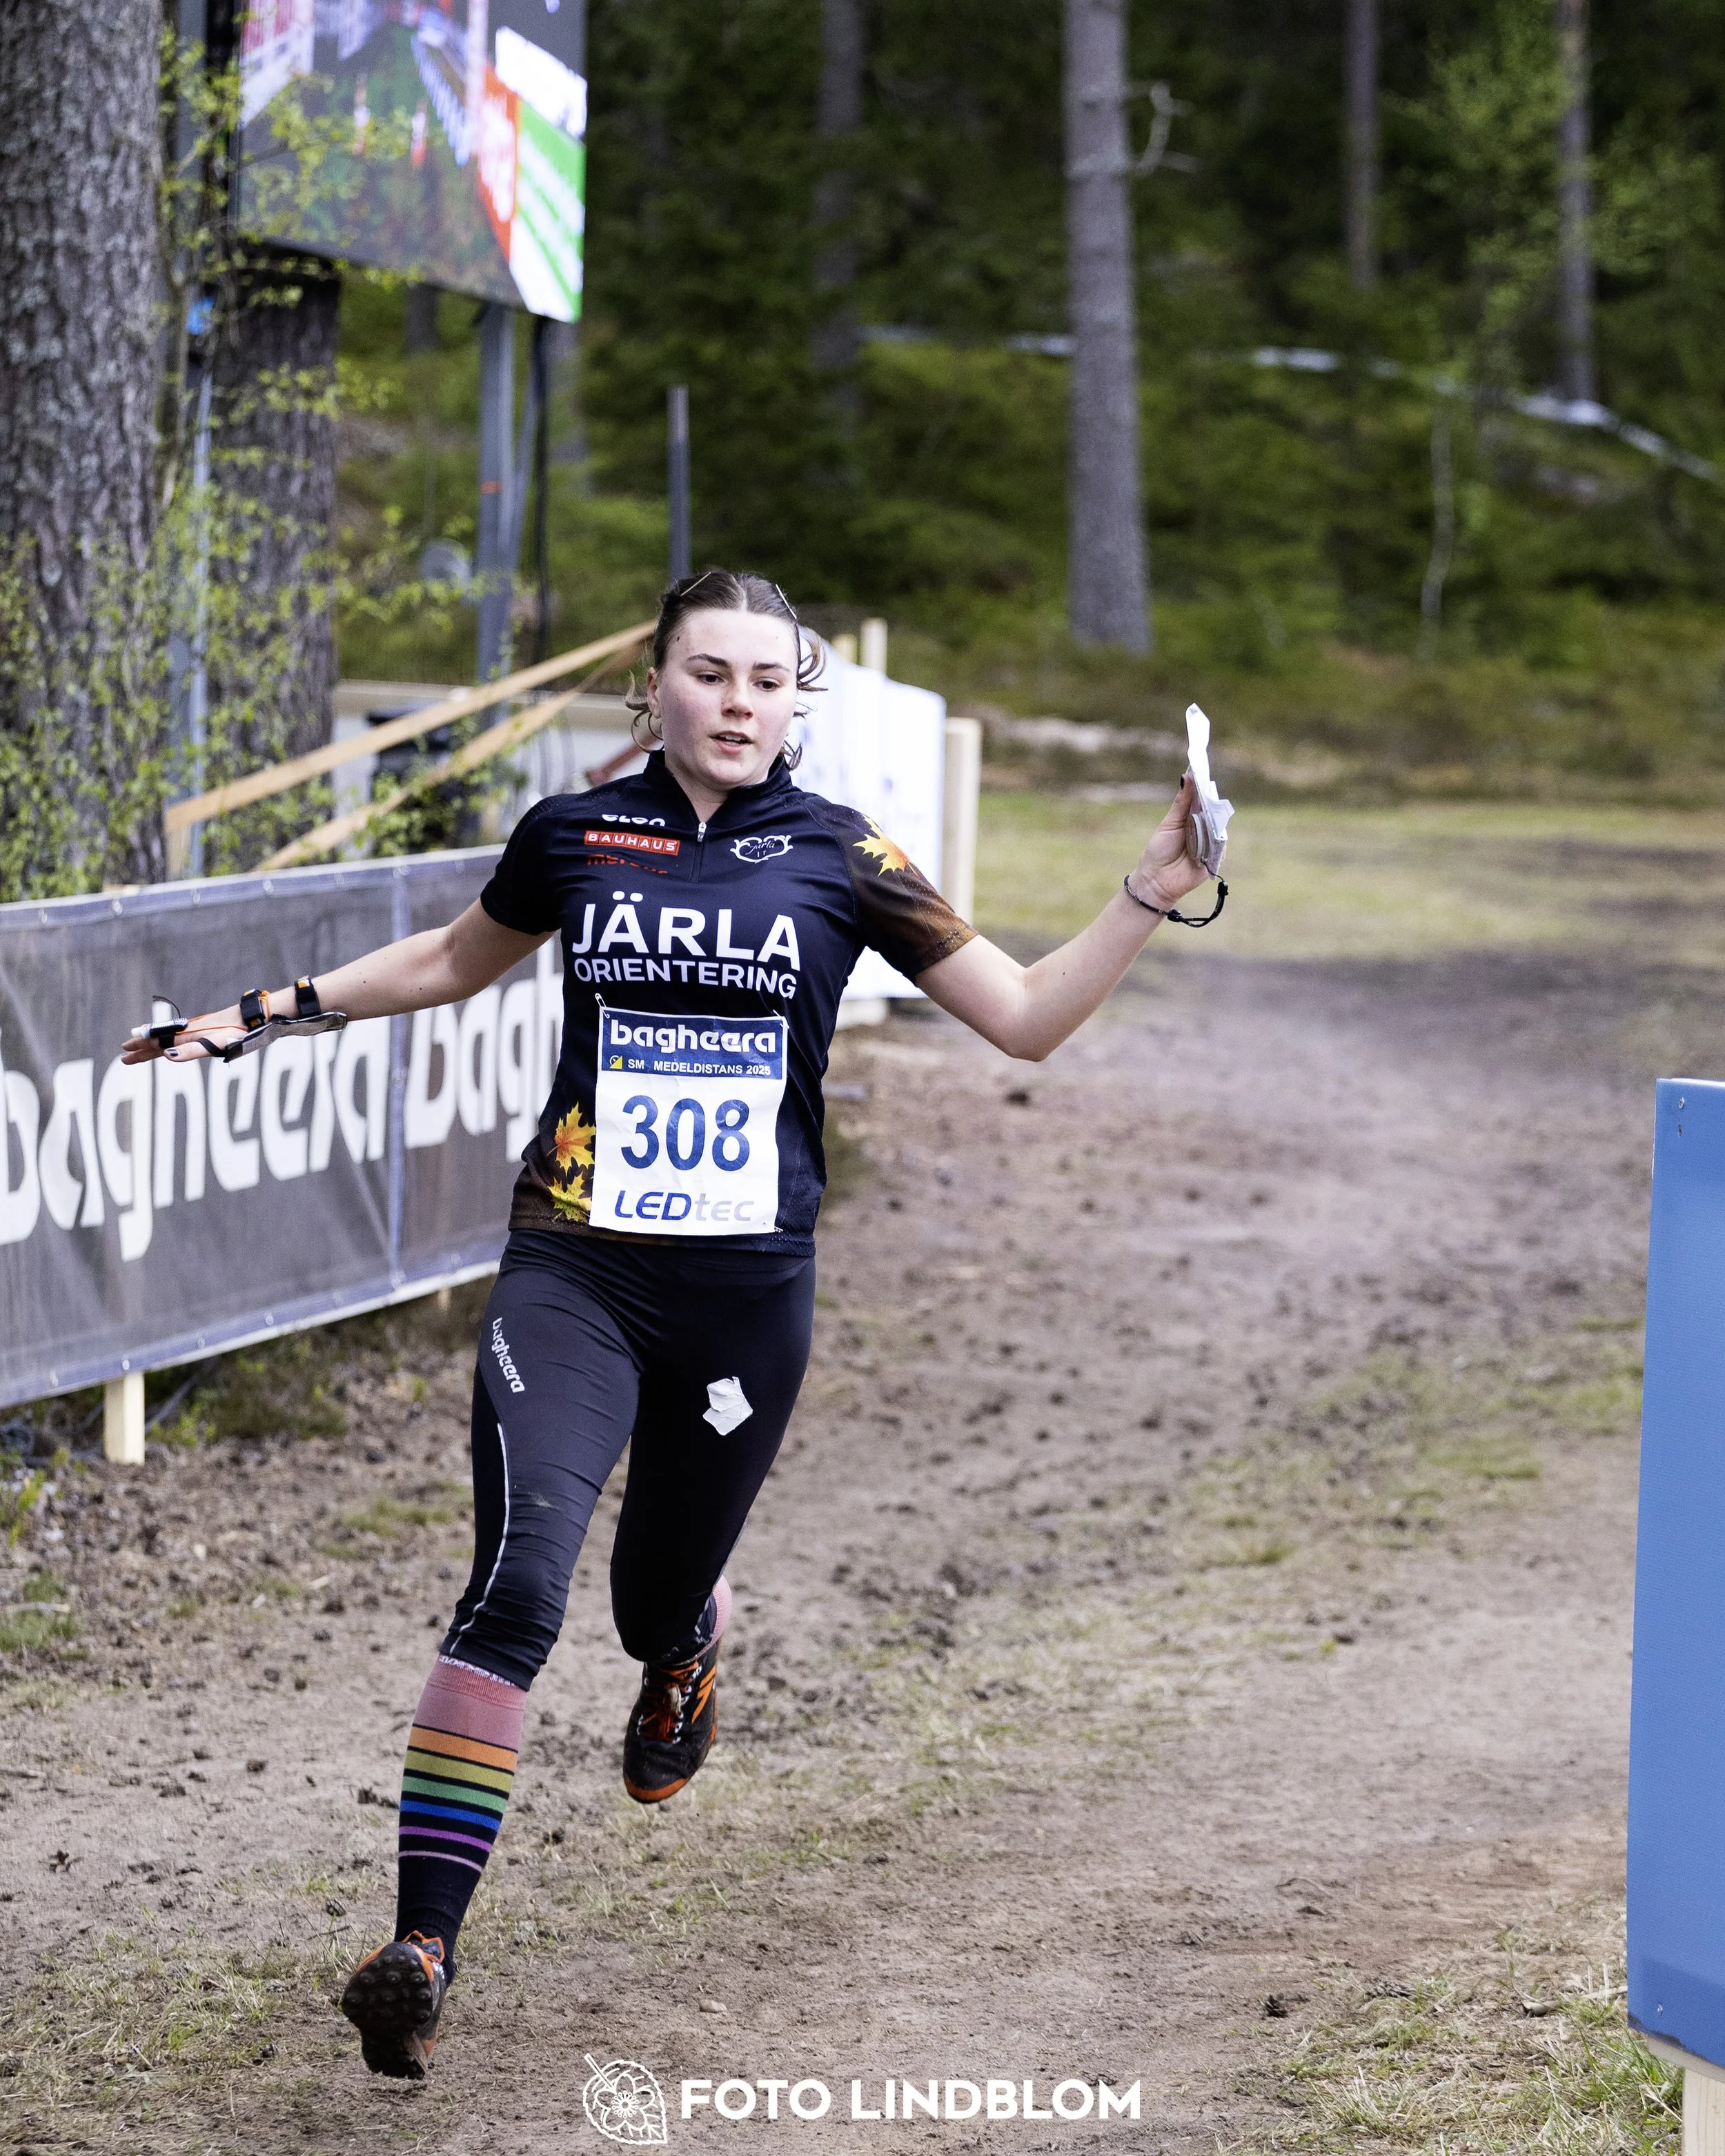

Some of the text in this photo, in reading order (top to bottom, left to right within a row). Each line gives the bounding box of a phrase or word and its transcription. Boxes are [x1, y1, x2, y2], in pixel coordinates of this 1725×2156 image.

[588, 833, 677, 851] BAUHAUS
[572, 891, 801, 971] JÄRLA
[575, 958, 797, 1000] ORIENTERING
[611, 1020, 776, 1054] bagheera
[628, 1058, 771, 1076] SM MEDELDISTANS 2025
[0, 1001, 388, 1263] bagheera
[621, 1095, 750, 1171] 308
[614, 1190, 755, 1221] LEDtec
[492, 1316, 525, 1394] bagheera
